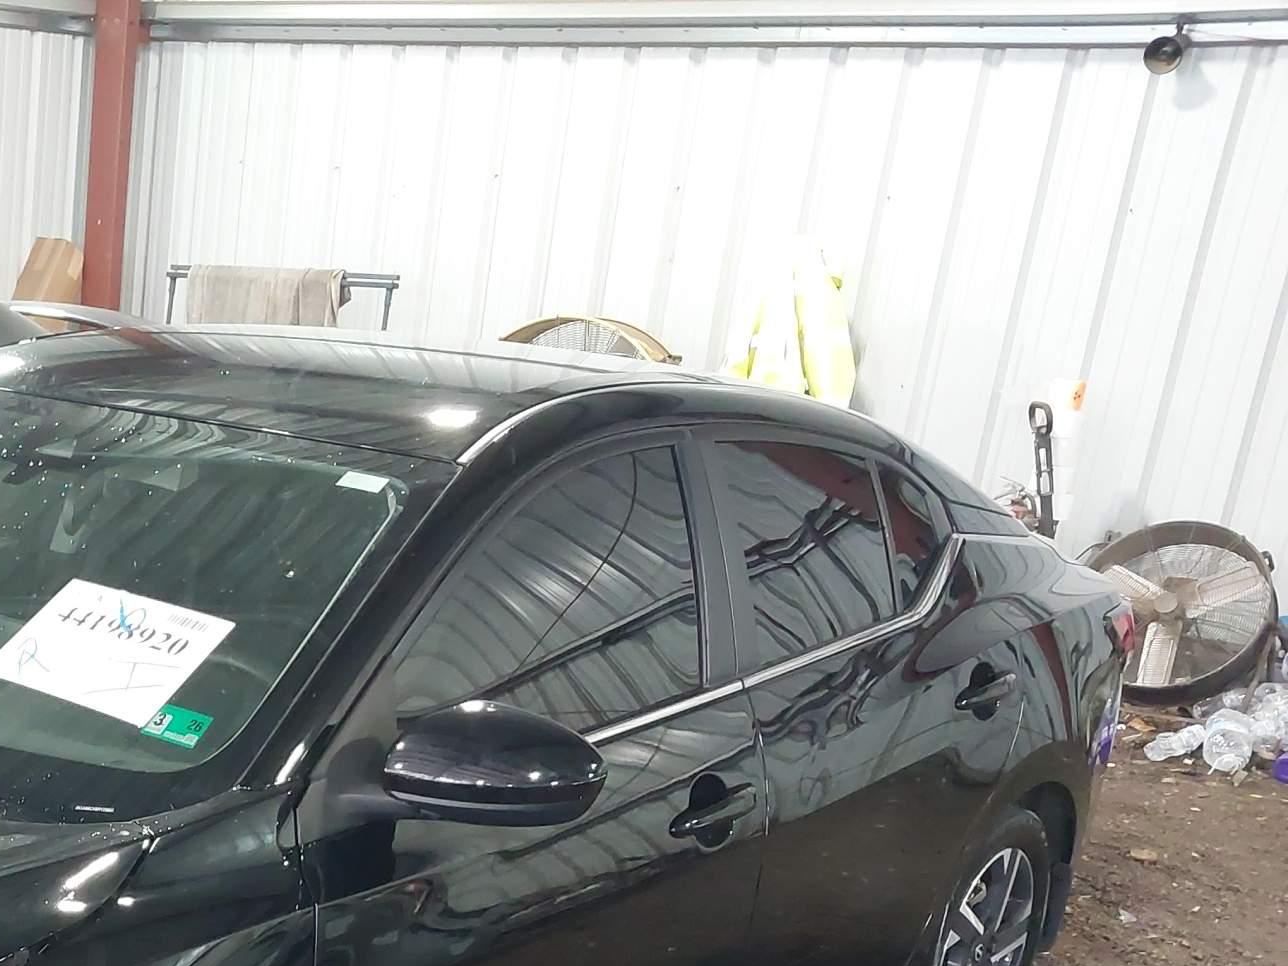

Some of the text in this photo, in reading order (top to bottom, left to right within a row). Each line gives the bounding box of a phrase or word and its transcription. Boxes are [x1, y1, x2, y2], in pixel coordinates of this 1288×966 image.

[57, 606, 190, 657] 44198920
[153, 712, 167, 726] 3
[186, 719, 205, 733] 26
